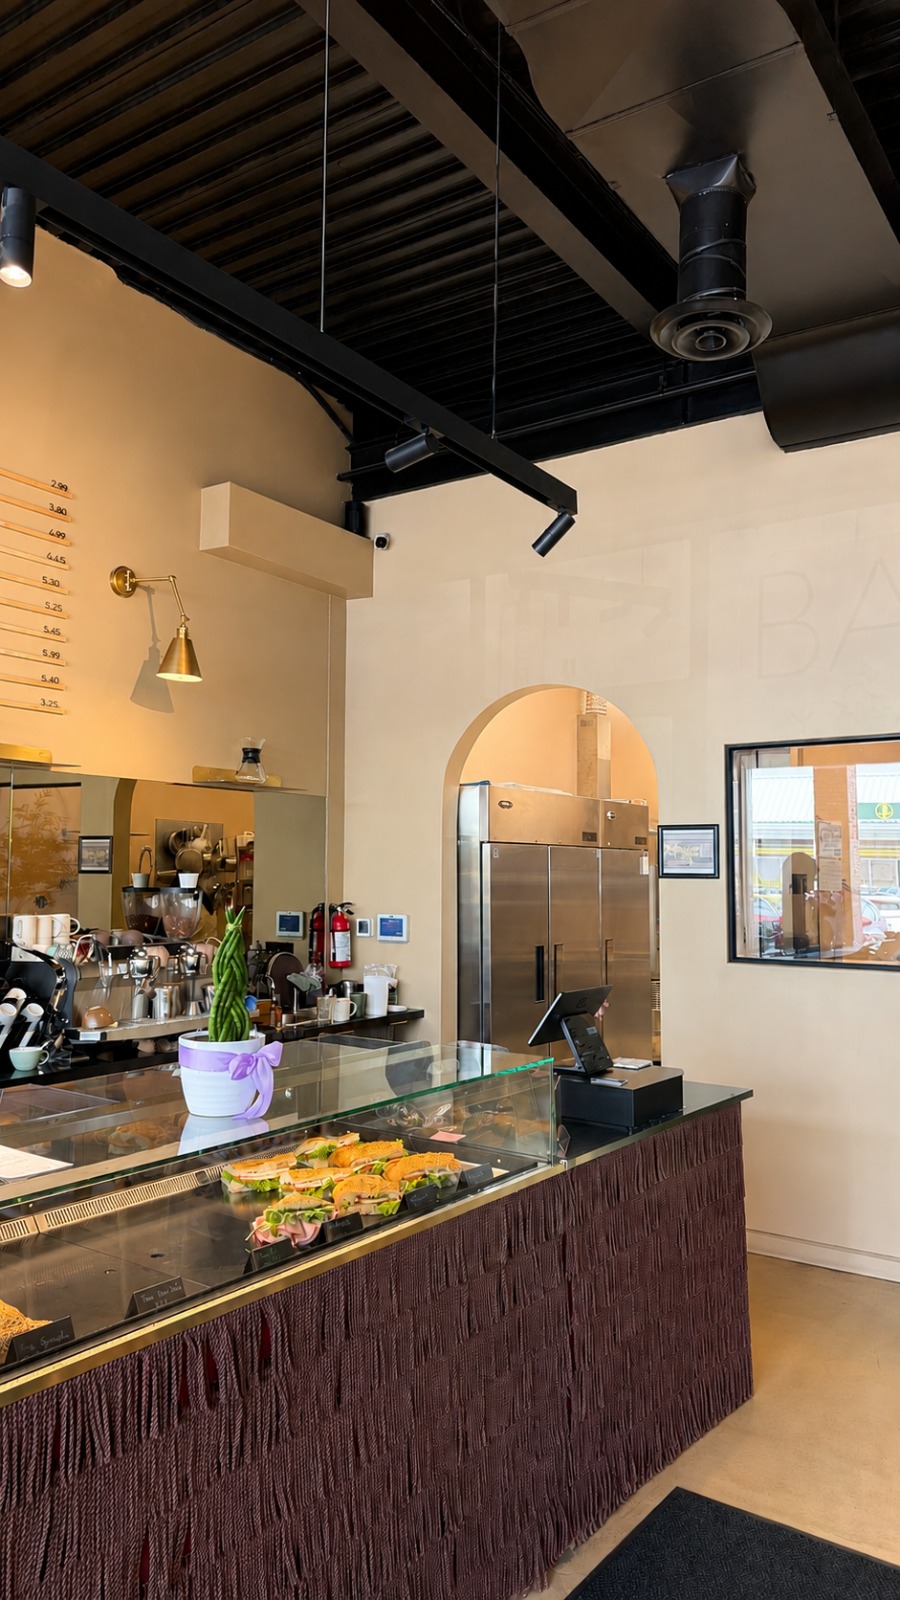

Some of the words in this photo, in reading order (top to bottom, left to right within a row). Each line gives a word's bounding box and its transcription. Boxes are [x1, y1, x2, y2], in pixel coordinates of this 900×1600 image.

[51, 480, 68, 492] 2.99
[49, 503, 67, 516] 3.80
[49, 529, 66, 540] 4.99
[42, 576, 60, 588] 5.30
[45, 602, 63, 612] 5.25
[42, 649, 61, 660] 5.99
[41, 675, 60, 685] 5.40
